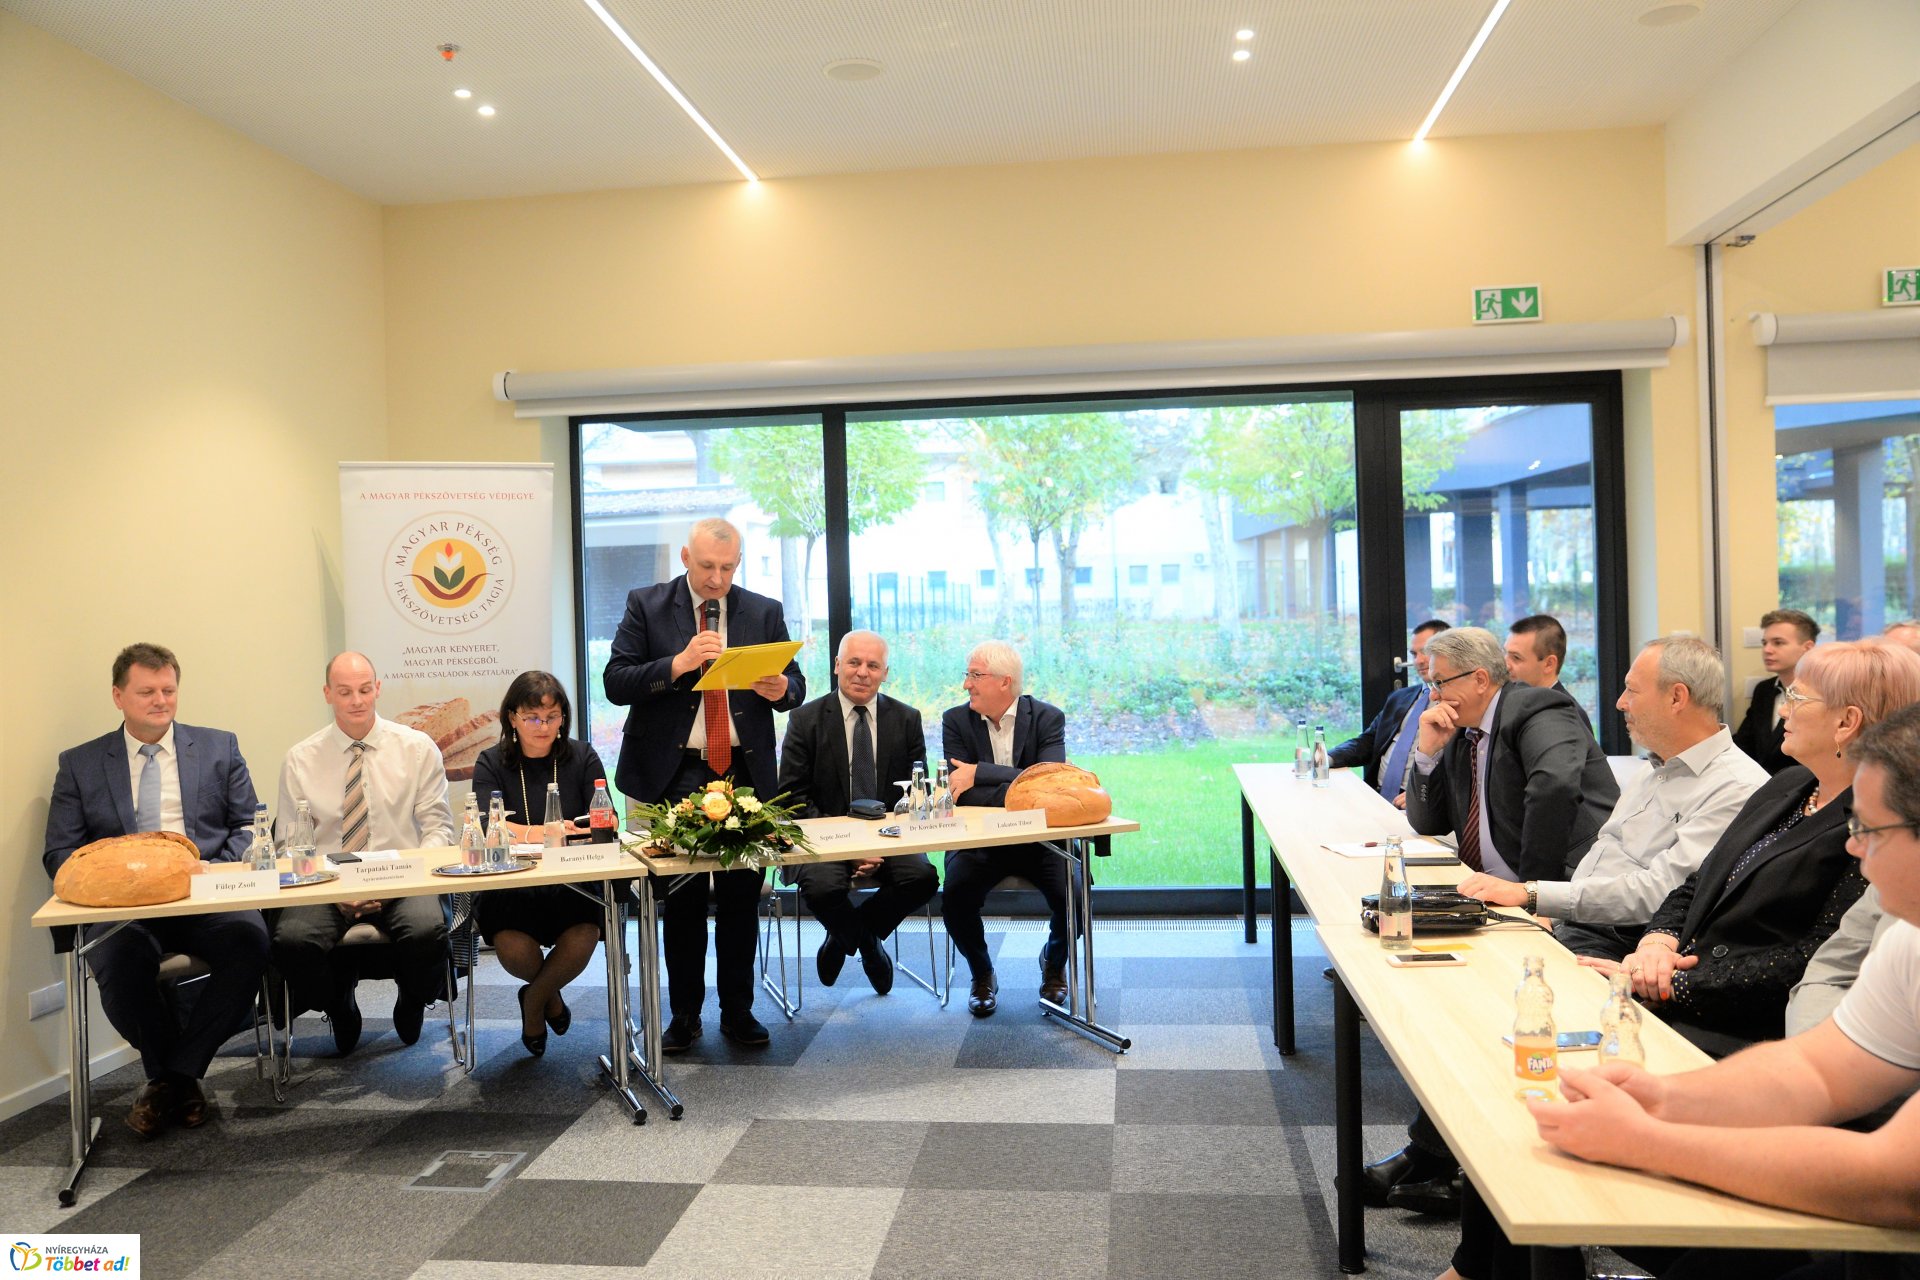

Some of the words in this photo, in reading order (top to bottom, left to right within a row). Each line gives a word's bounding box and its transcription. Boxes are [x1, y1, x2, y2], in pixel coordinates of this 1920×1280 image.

[360, 492, 366, 501] A
[370, 492, 410, 501] MAGYAR
[395, 521, 449, 567] MAGYAR
[456, 522, 503, 566] PÉKSÉG
[394, 580, 479, 625] PÉKSZÖVETSÉG
[479, 578, 505, 613] TAGJA
[403, 658, 443, 668] MAGYAR
[392, 672, 425, 680] MAGYAR
[355, 864, 389, 875] Tarpataki
[389, 862, 412, 871] Tamás
[215, 883, 236, 891] Fülep
[237, 881, 256, 889] Zsolt
